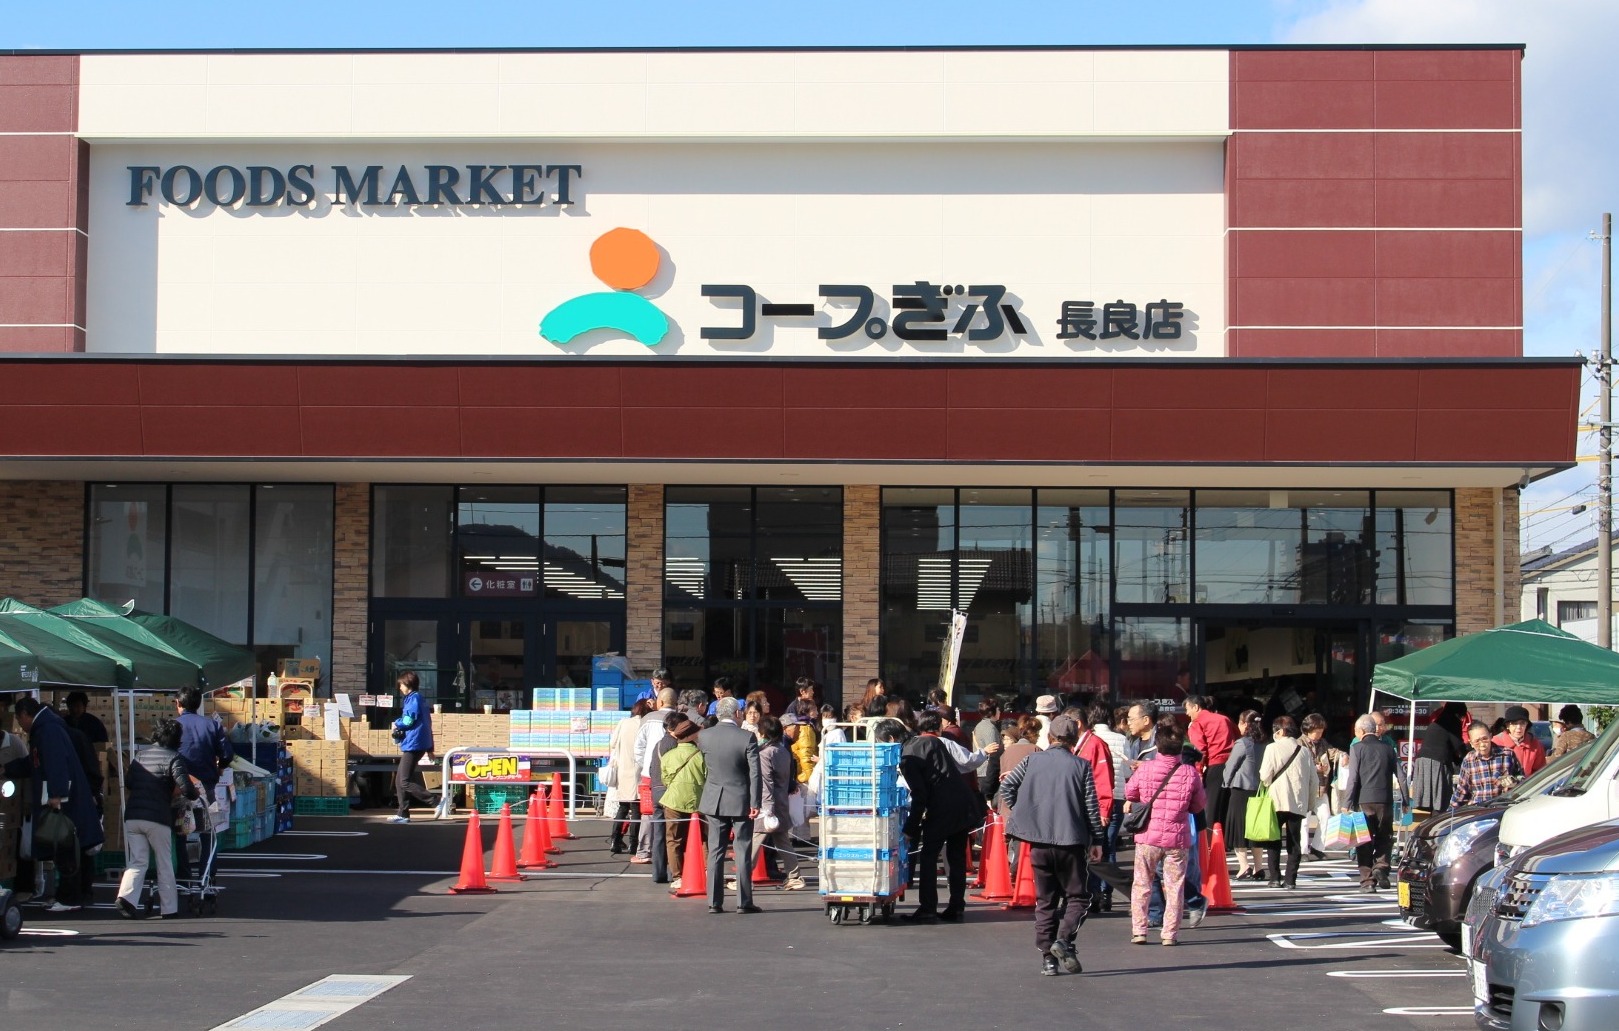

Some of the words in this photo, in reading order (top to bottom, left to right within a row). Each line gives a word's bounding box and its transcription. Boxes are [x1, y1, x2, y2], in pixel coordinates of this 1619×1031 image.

[126, 165, 316, 207] FOODS
[331, 164, 582, 206] MARKET
[701, 280, 1029, 341] コープぎふ
[1057, 299, 1184, 341] 長良店
[486, 579, 516, 589] 化粧室
[465, 756, 518, 779] OPEN
